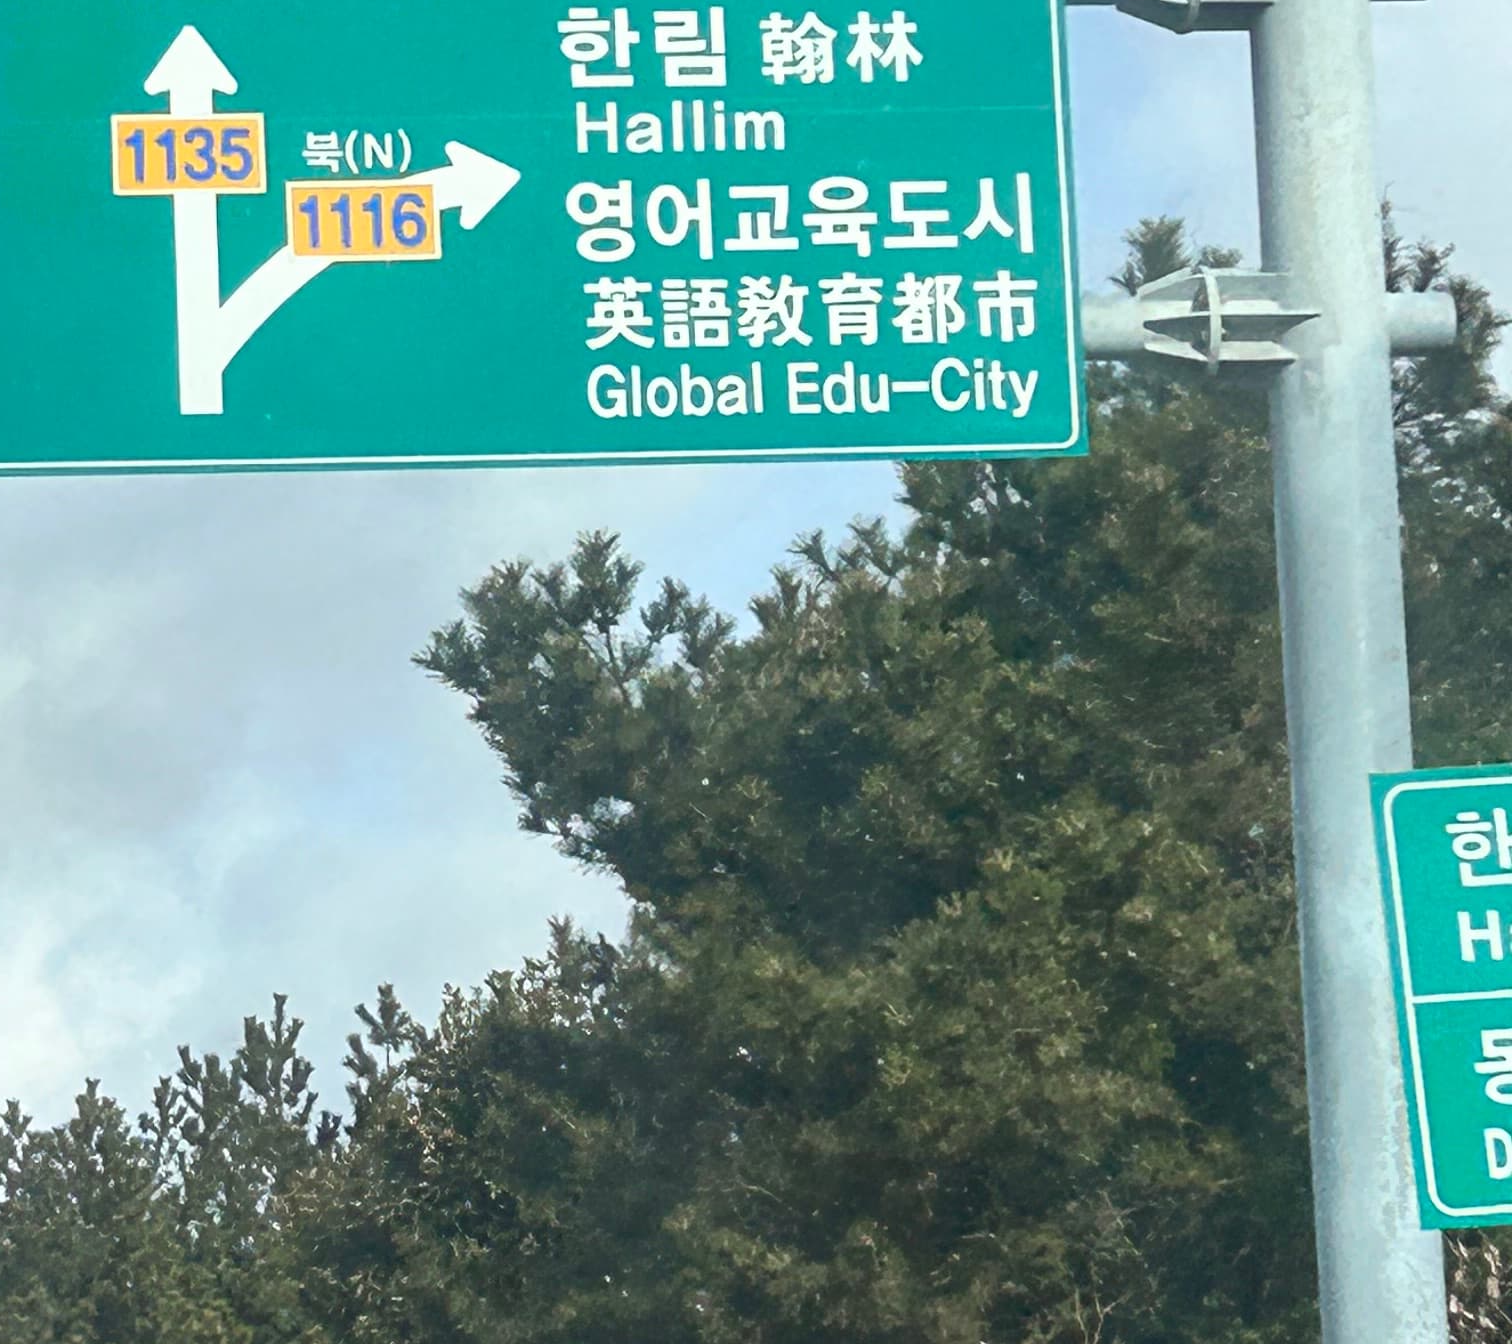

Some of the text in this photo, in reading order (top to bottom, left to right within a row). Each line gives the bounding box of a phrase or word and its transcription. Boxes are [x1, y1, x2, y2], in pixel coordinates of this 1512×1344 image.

[557, 6, 923, 88] 한림 翰林
[301, 128, 412, 174] 북(N)
[575, 99, 785, 154] Hallim
[125, 128, 252, 181] 1135
[299, 193, 427, 248] 1116
[565, 172, 1034, 263] 영어교육도시
[587, 357, 1039, 419] Global Edu-City
[1456, 909, 1512, 962] H
